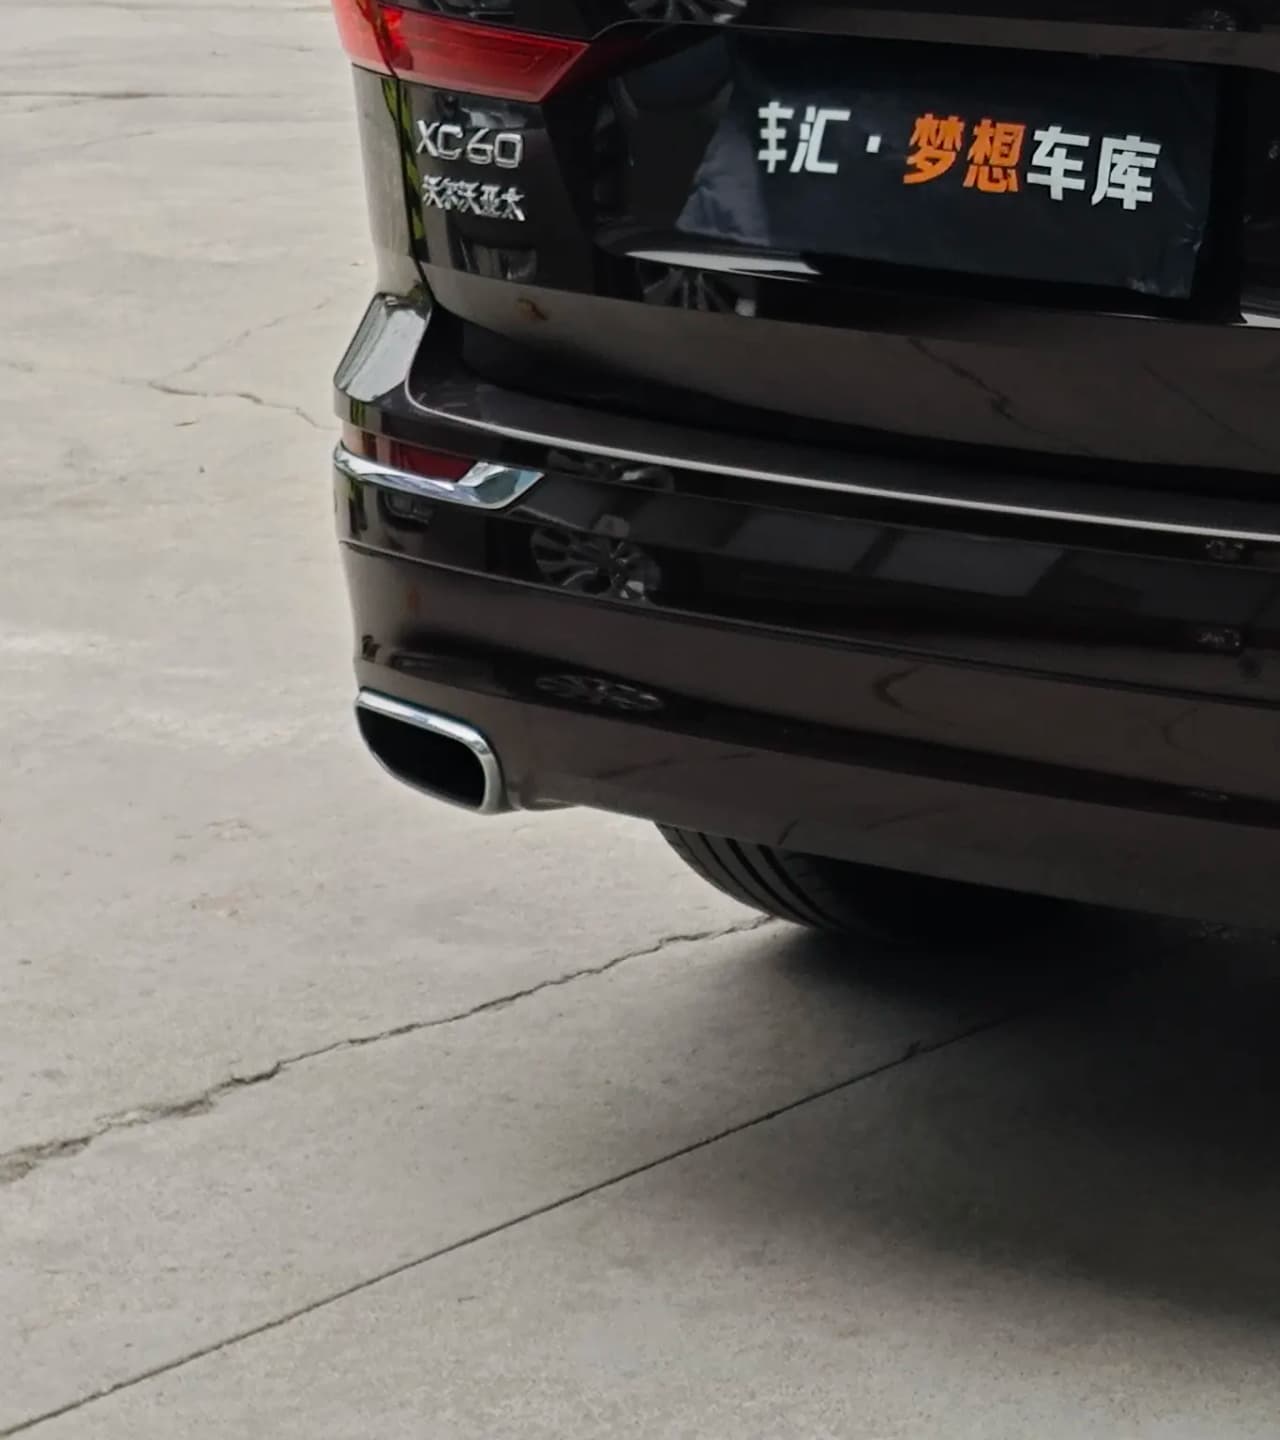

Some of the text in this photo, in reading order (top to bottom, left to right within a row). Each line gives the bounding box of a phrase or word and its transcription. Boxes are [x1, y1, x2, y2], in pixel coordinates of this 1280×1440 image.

[416, 120, 523, 169] XC60
[422, 174, 526, 222] 沃尔沃亚太
